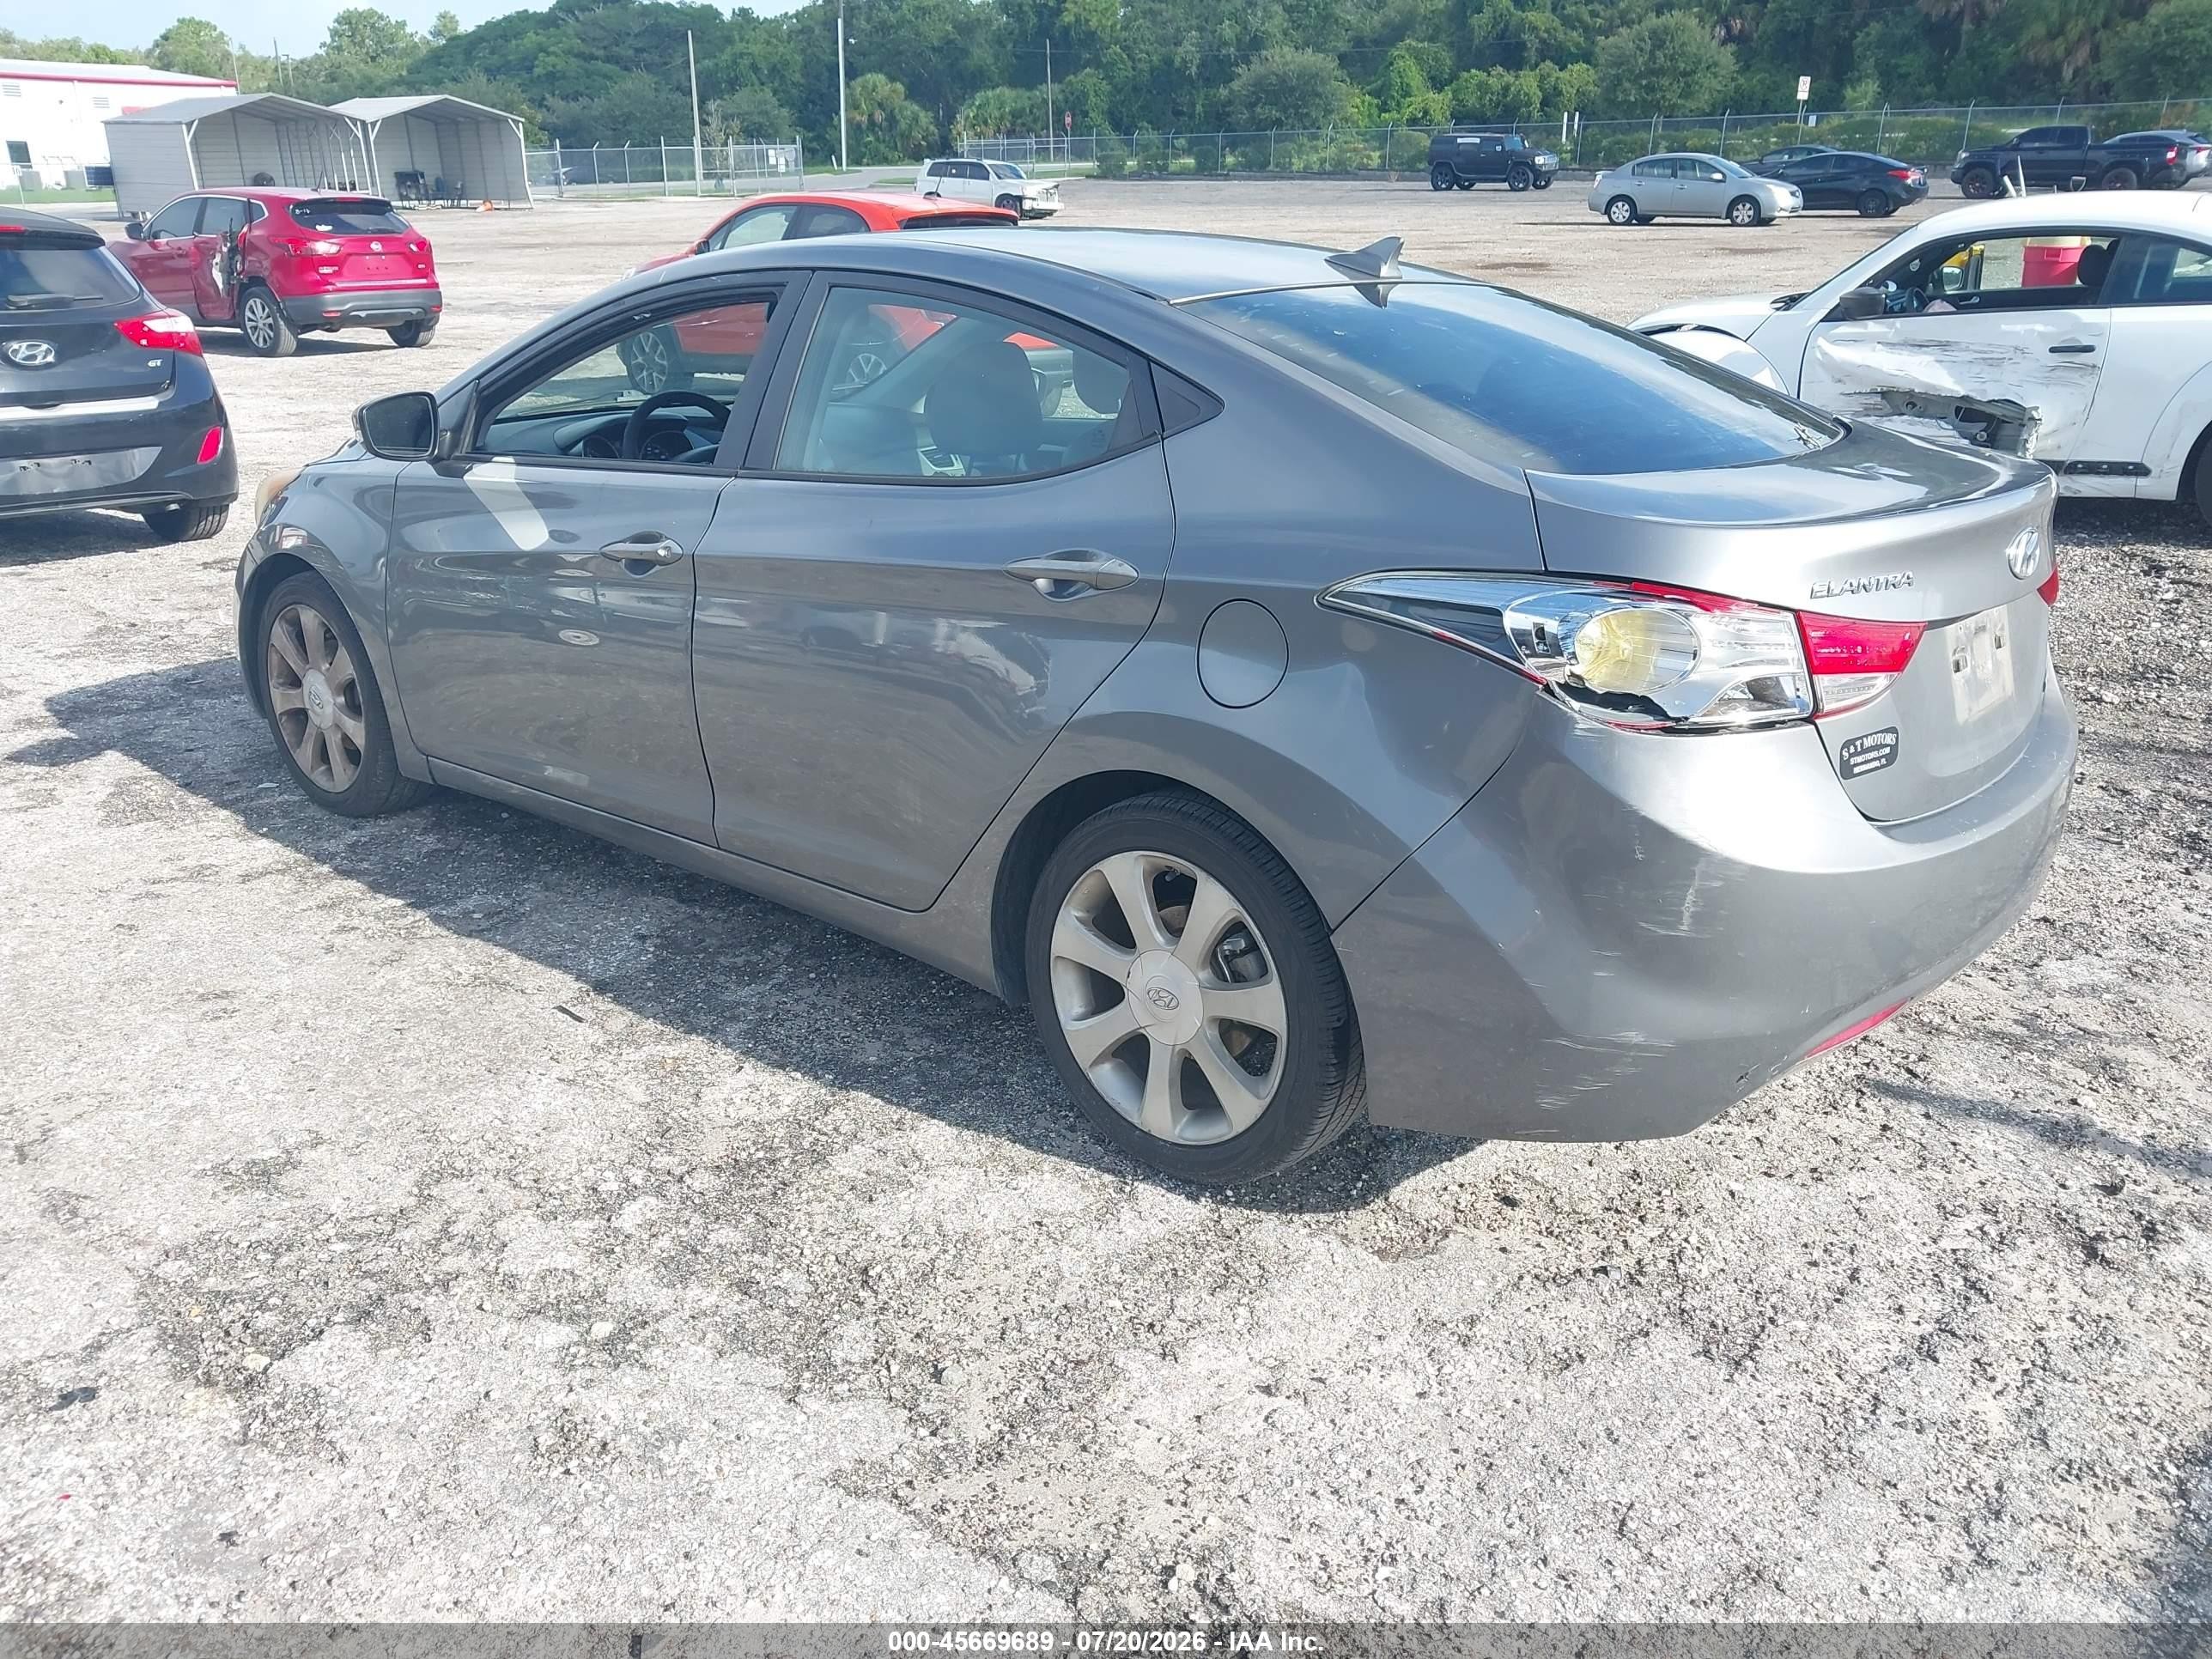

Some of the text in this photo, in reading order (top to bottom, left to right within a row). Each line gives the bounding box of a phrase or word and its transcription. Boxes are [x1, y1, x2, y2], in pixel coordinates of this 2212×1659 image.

[148, 359, 163, 368] GT
[1810, 571, 1915, 599] ELANTRA
[1842, 732, 1897, 761] S & T MOTORS
[1850, 746, 1891, 765] STMOTORS.COM
